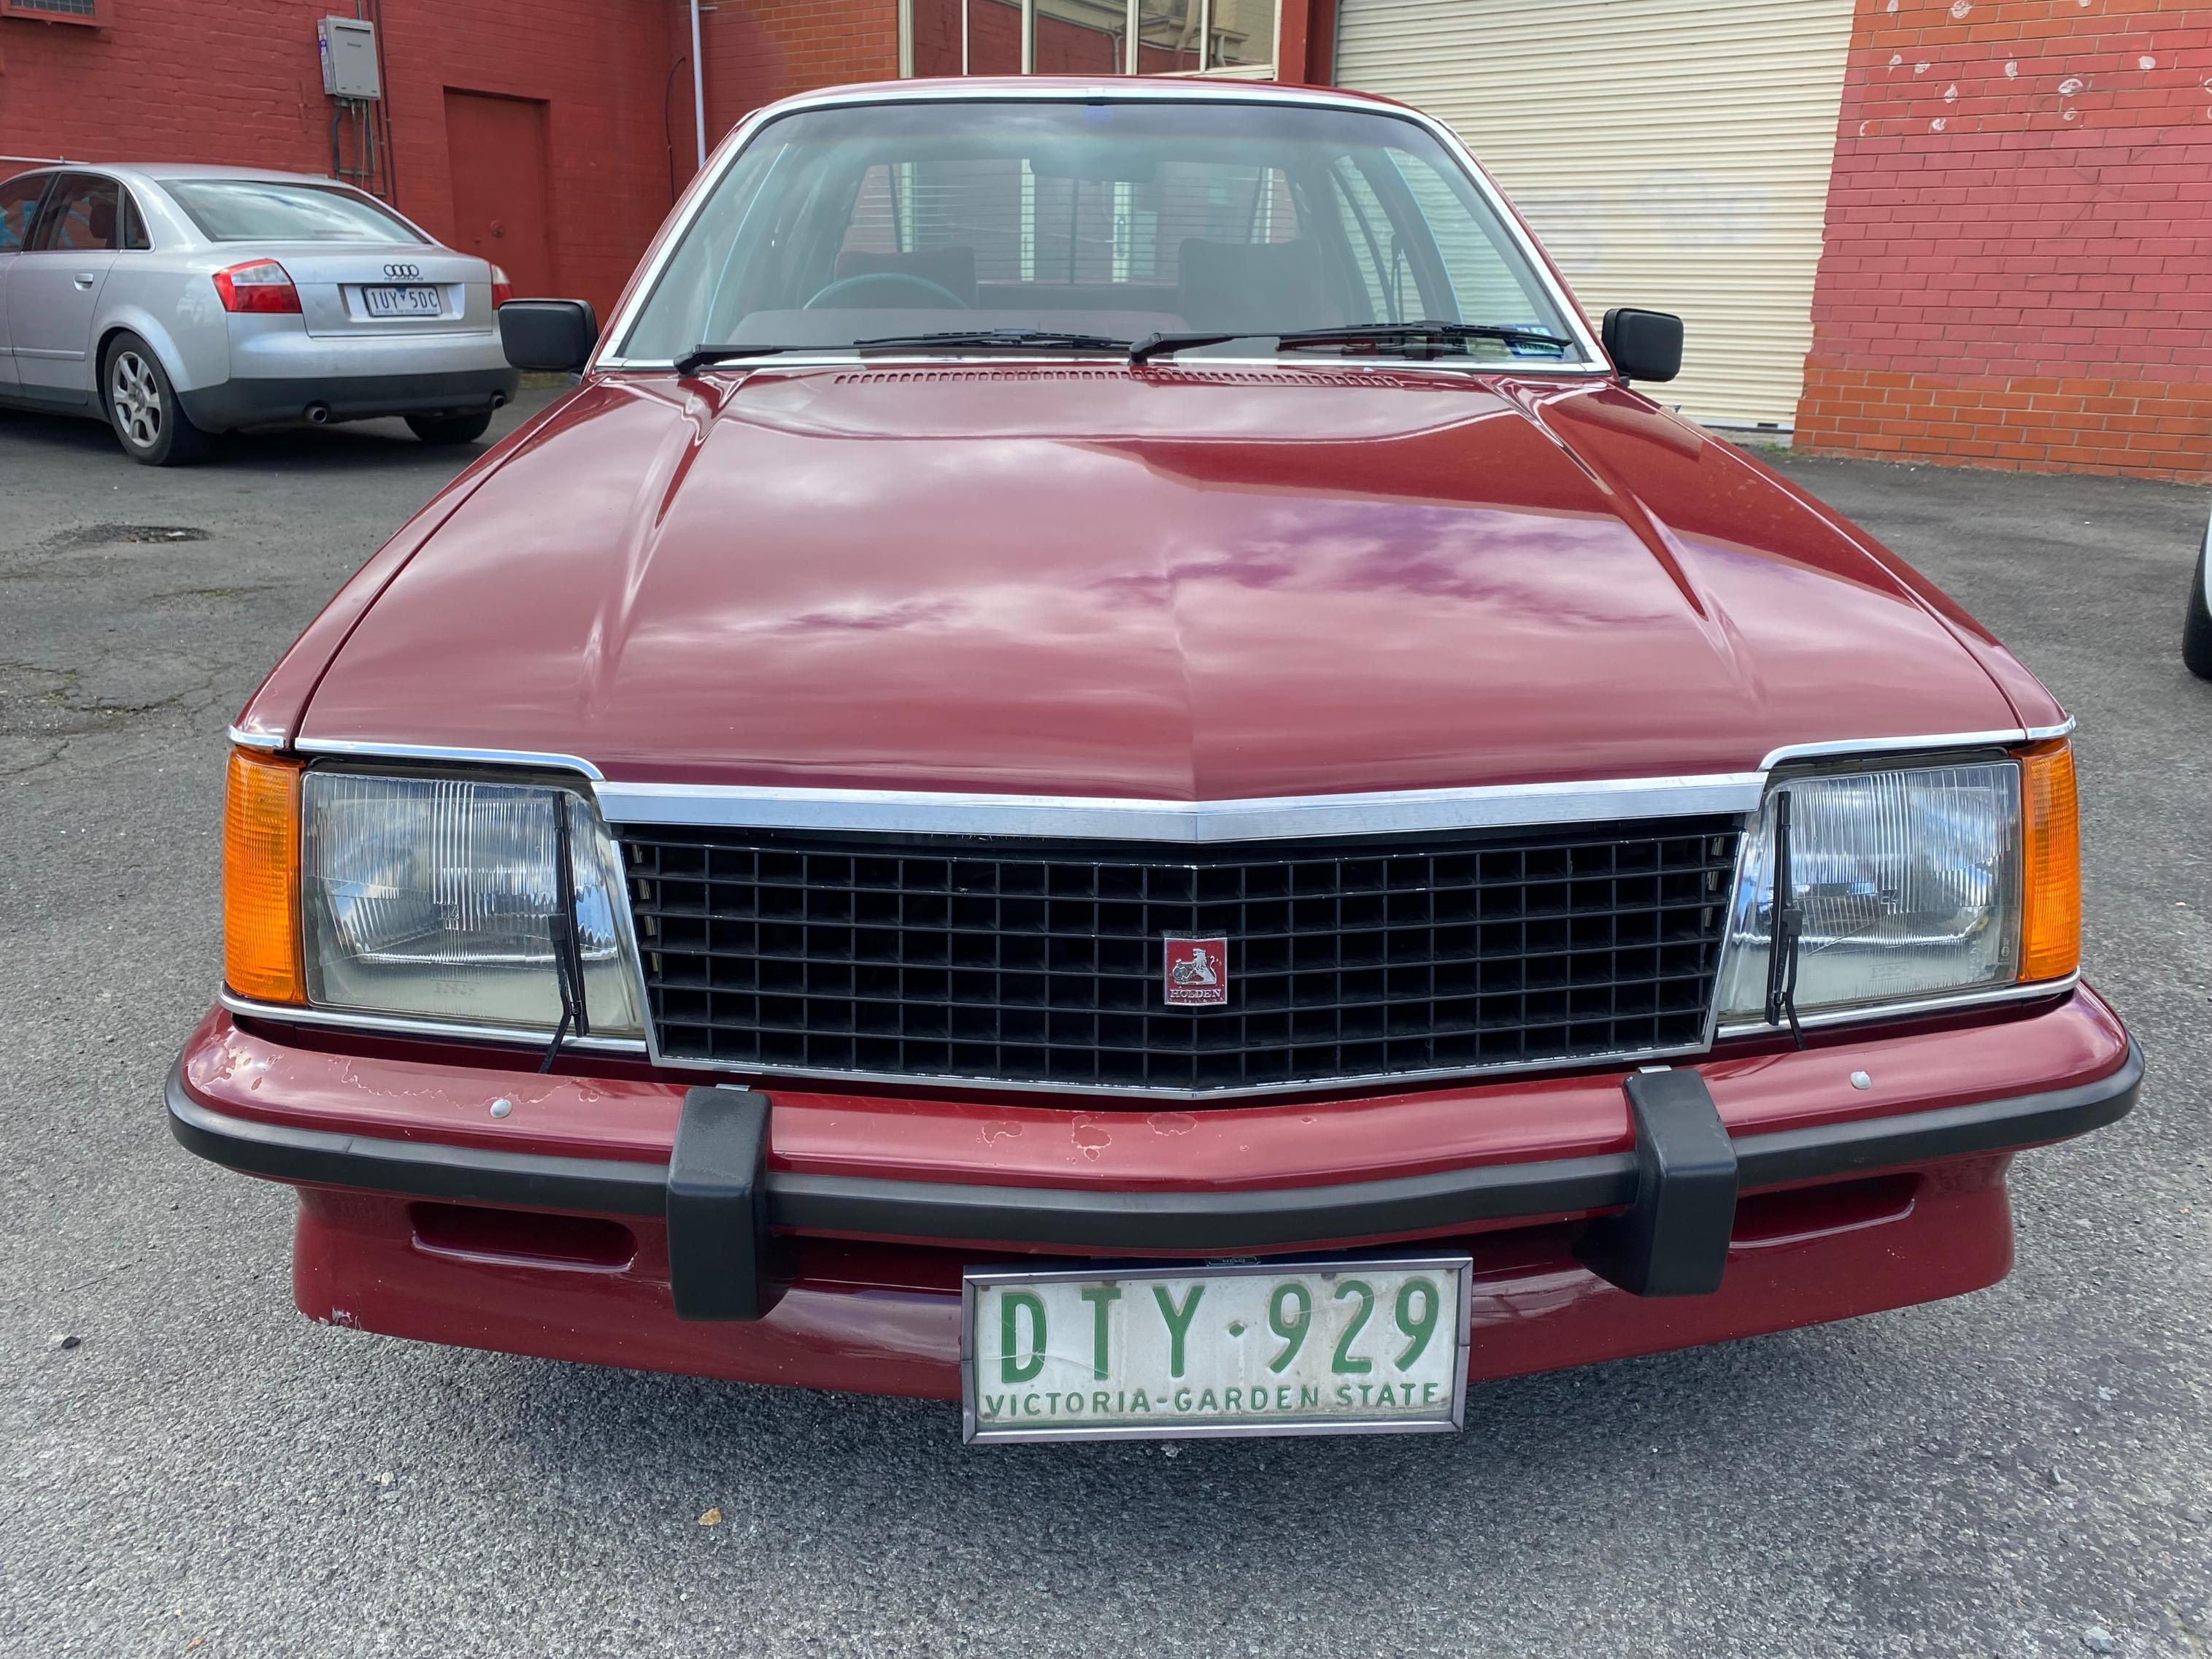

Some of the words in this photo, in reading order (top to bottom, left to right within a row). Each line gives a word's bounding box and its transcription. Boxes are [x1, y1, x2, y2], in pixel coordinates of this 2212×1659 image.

[371, 291, 398, 309] 1UY
[409, 291, 437, 308] 5DC
[1169, 989, 1222, 998] HOLDEN
[1336, 1382, 1439, 1409] STATE
